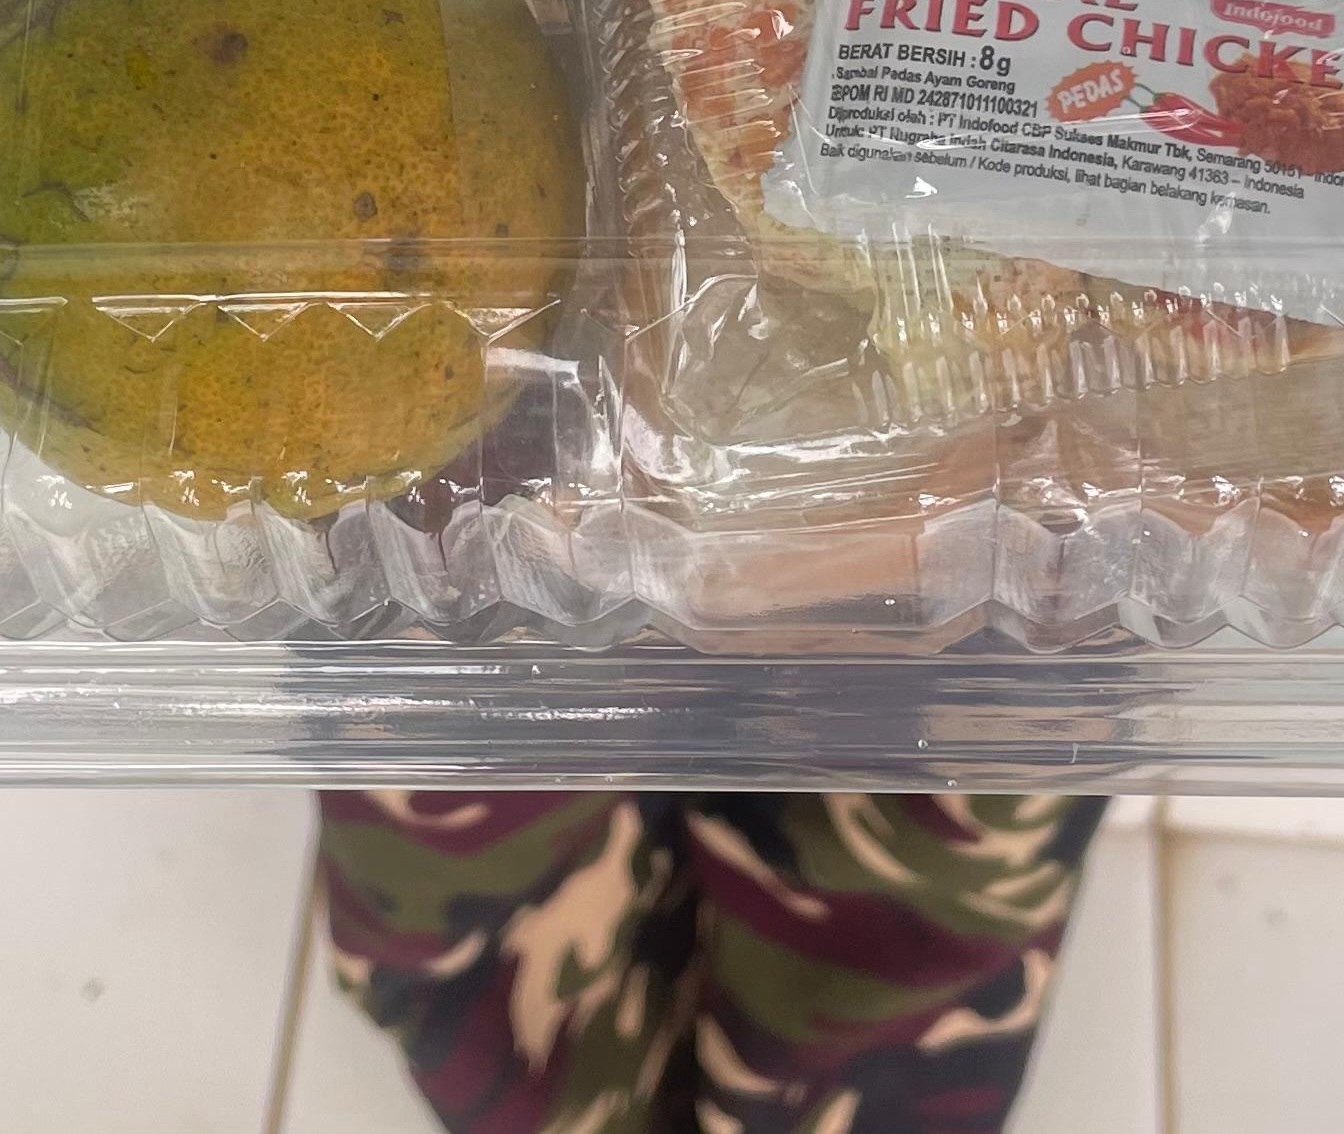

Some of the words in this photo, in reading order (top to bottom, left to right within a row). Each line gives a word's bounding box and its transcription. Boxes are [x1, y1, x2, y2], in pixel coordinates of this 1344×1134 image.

[1223, 3, 1324, 30] Indofood
[838, 43, 894, 60] BERAT
[897, 44, 966, 67] BERSIH
[836, 65, 878, 80] Sambal
[881, 66, 922, 83] Pedas
[924, 70, 962, 88] Ayam
[966, 75, 1016, 95] Goreng
[873, 85, 889, 102] RI
[891, 86, 915, 104] MD
[1057, 68, 1124, 113] PEDAS
[828, 106, 895, 123] Diproduksi
[897, 109, 926, 125] oleh
[937, 111, 956, 128] PT
[959, 114, 1018, 134] Indofood
[1021, 122, 1052, 139] CBP
[1054, 125, 1103, 146] Sukses
[1106, 134, 1162, 155] Makmur
[1164, 142, 1193, 163] Tbk,
[1196, 147, 1261, 174] Semarang
[820, 142, 845, 158] Baik
[847, 143, 913, 162] digunakan
[914, 151, 967, 168] sebelum
[978, 156, 1011, 173] Kode
[1013, 162, 1071, 185] produksi,
[1075, 167, 1101, 187] lihat
[1103, 172, 1147, 194] bagian
[1150, 179, 1208, 207] belakang
[1210, 189, 1271, 215] kemasan.
[825, 123, 866, 139] Untuk
[990, 137, 1045, 158] Citarasa
[1048, 144, 1118, 170] Indonesia,
[1122, 154, 1186, 182] Karawang
[1188, 166, 1230, 186] 41363
[1244, 174, 1305, 200] Indonesia
